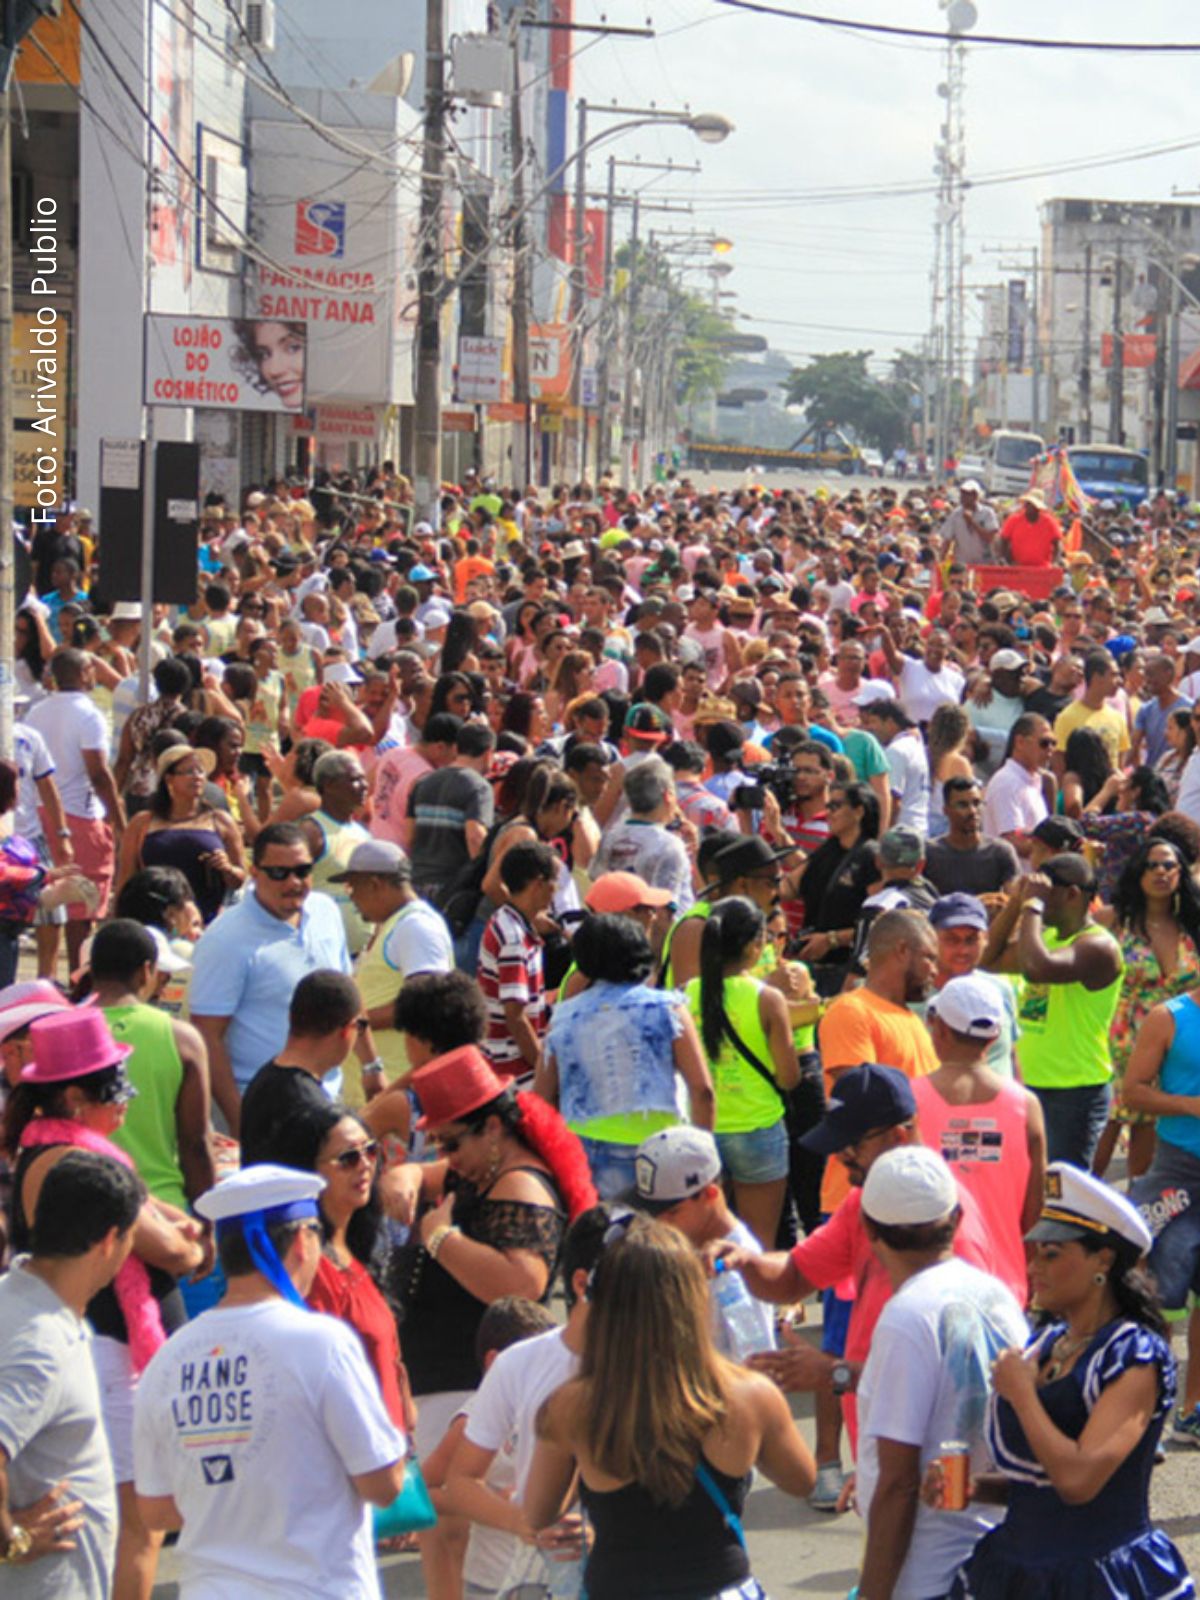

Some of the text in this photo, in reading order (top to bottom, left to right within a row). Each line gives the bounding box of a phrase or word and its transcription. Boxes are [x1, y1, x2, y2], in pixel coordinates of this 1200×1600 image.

[259, 264, 376, 291] FARMÁCIA
[173, 324, 222, 349] LOJÃO
[185, 352, 209, 372] DO
[153, 377, 239, 402] COSMÉTICO
[180, 1354, 248, 1393] HANG
[171, 1389, 253, 1428] LOOSE
